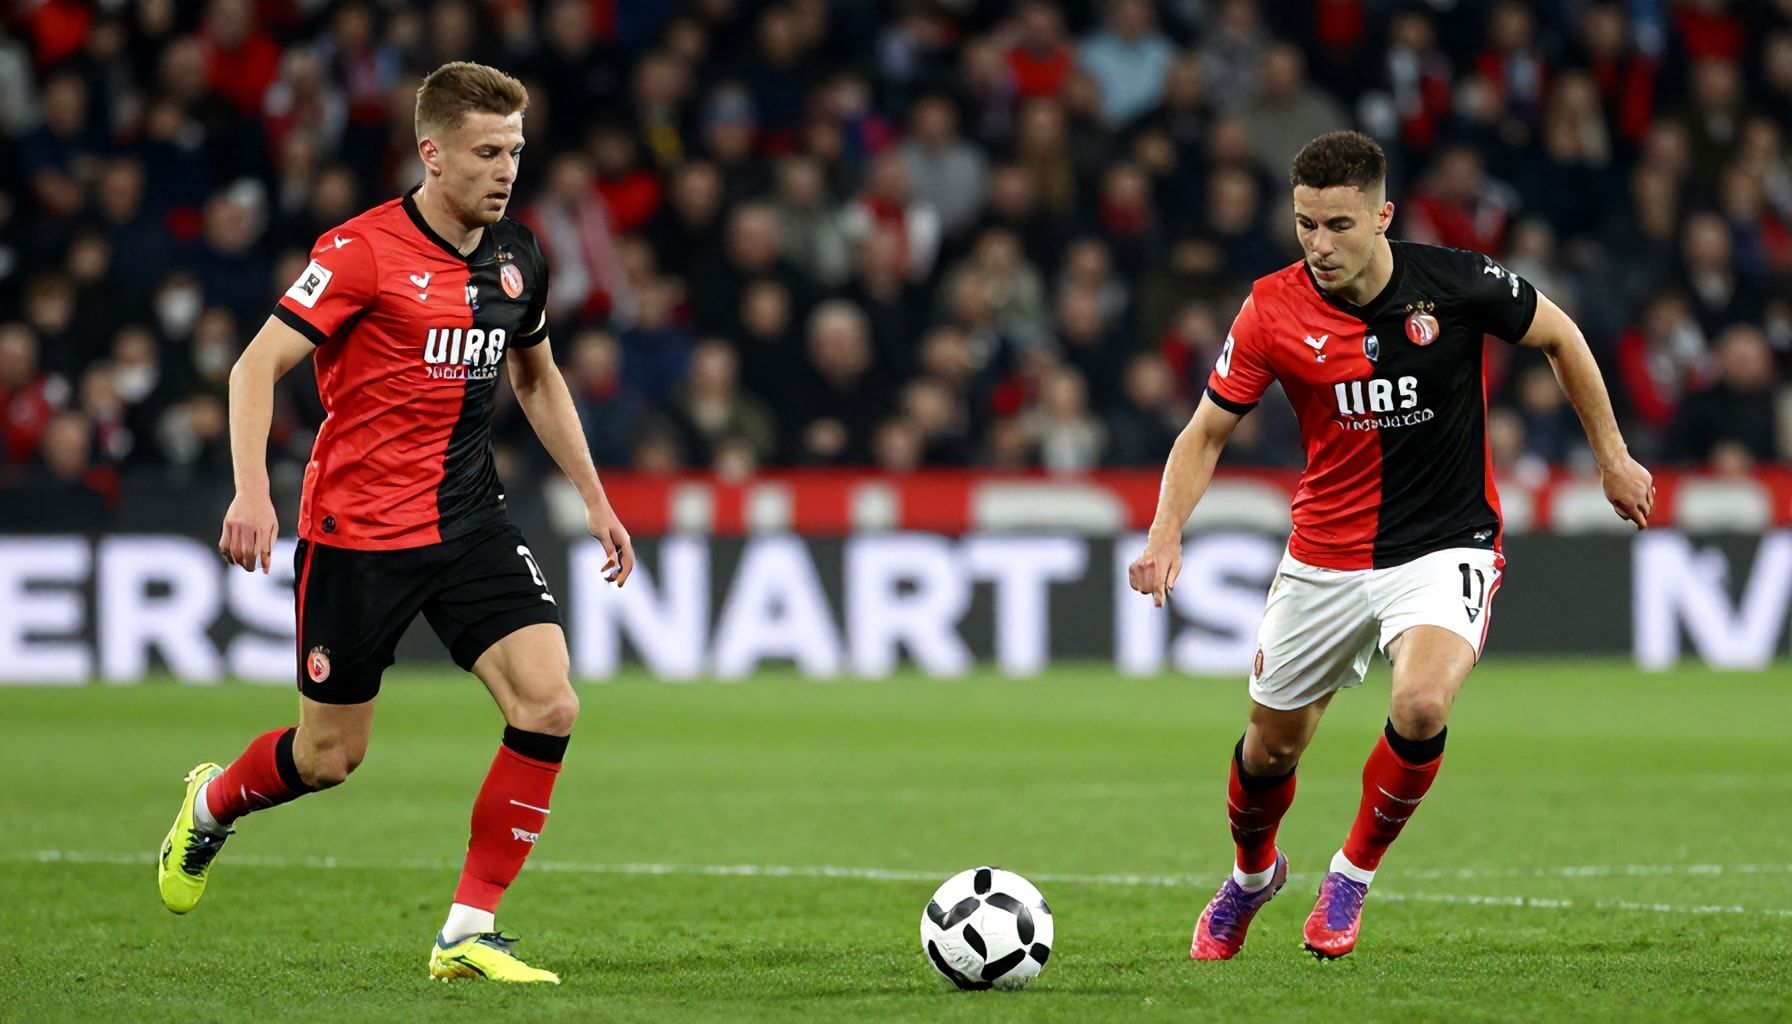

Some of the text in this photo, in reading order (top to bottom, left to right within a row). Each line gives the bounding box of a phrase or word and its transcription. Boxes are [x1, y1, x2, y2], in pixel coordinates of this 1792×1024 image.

[0, 534, 296, 685] ERS
[568, 531, 1089, 680] NART
[1117, 532, 1287, 676] IS
